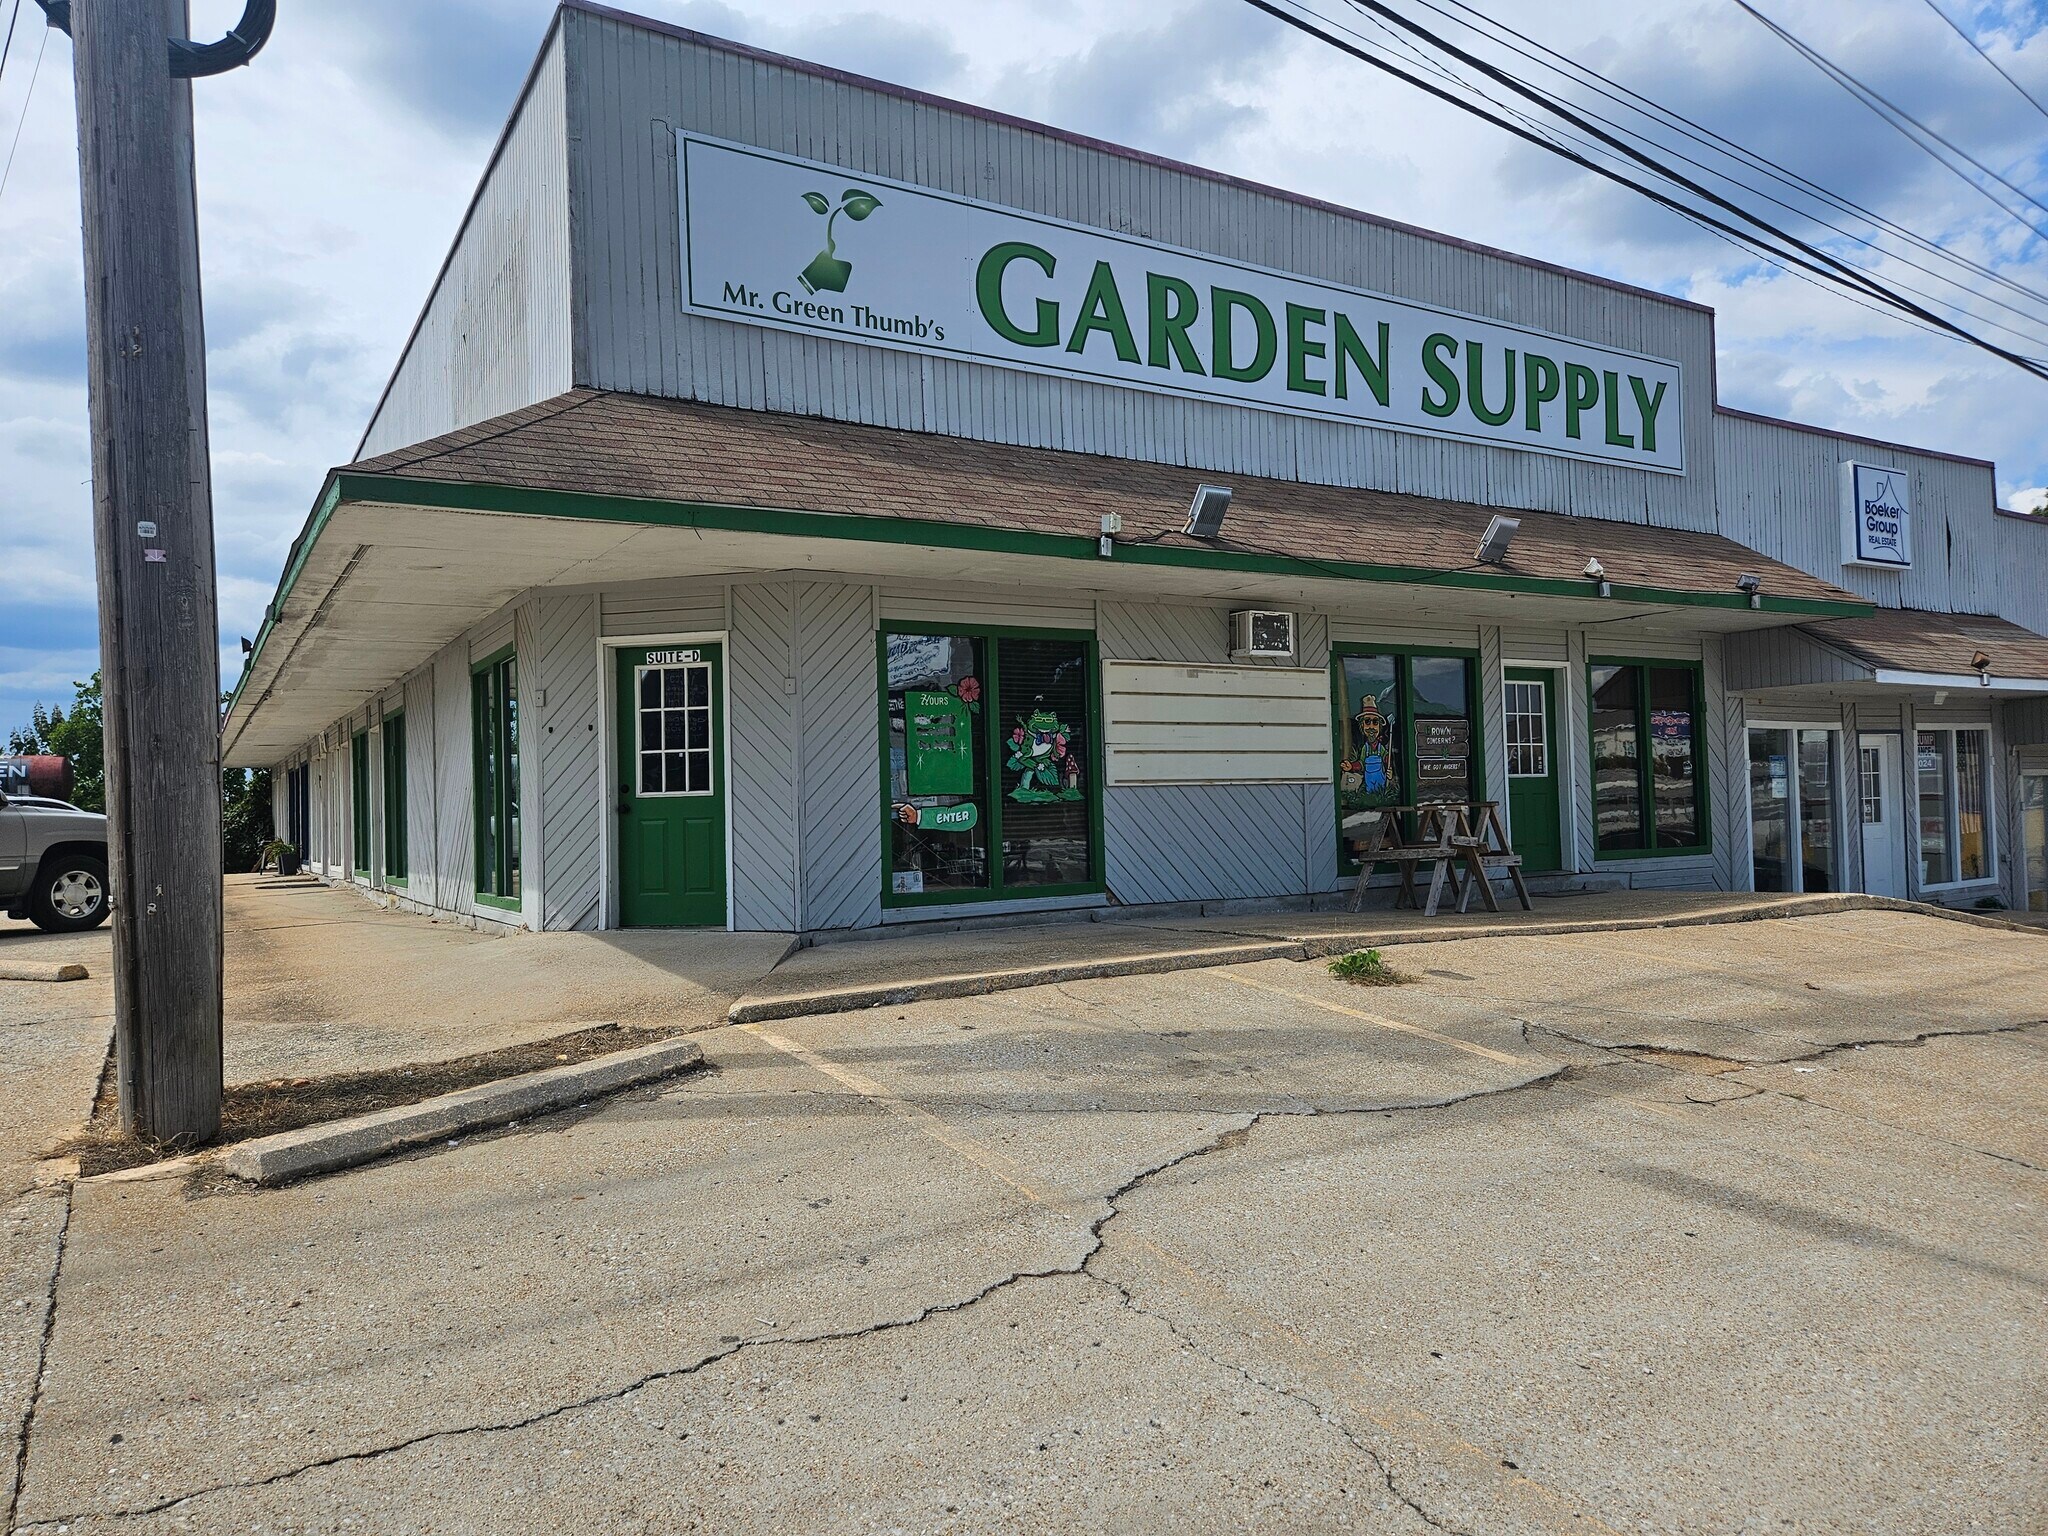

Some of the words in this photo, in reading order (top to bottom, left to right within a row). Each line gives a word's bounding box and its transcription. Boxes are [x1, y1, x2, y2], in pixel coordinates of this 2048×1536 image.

[723, 281, 764, 309] Mr.
[772, 291, 844, 324] Green
[850, 304, 945, 341] Thumb's
[976, 241, 1390, 408] GARDEN
[1421, 332, 1668, 453] SUPPLY
[1865, 499, 1900, 519] Boeker
[1866, 515, 1898, 537] Group
[1868, 535, 1881, 545] REAL
[1881, 537, 1897, 547] ESTATE
[647, 650, 699, 664] SUITE-D
[1918, 735, 1934, 745] UMP
[1918, 759, 1932, 768] 024
[936, 810, 969, 824] ENTER
